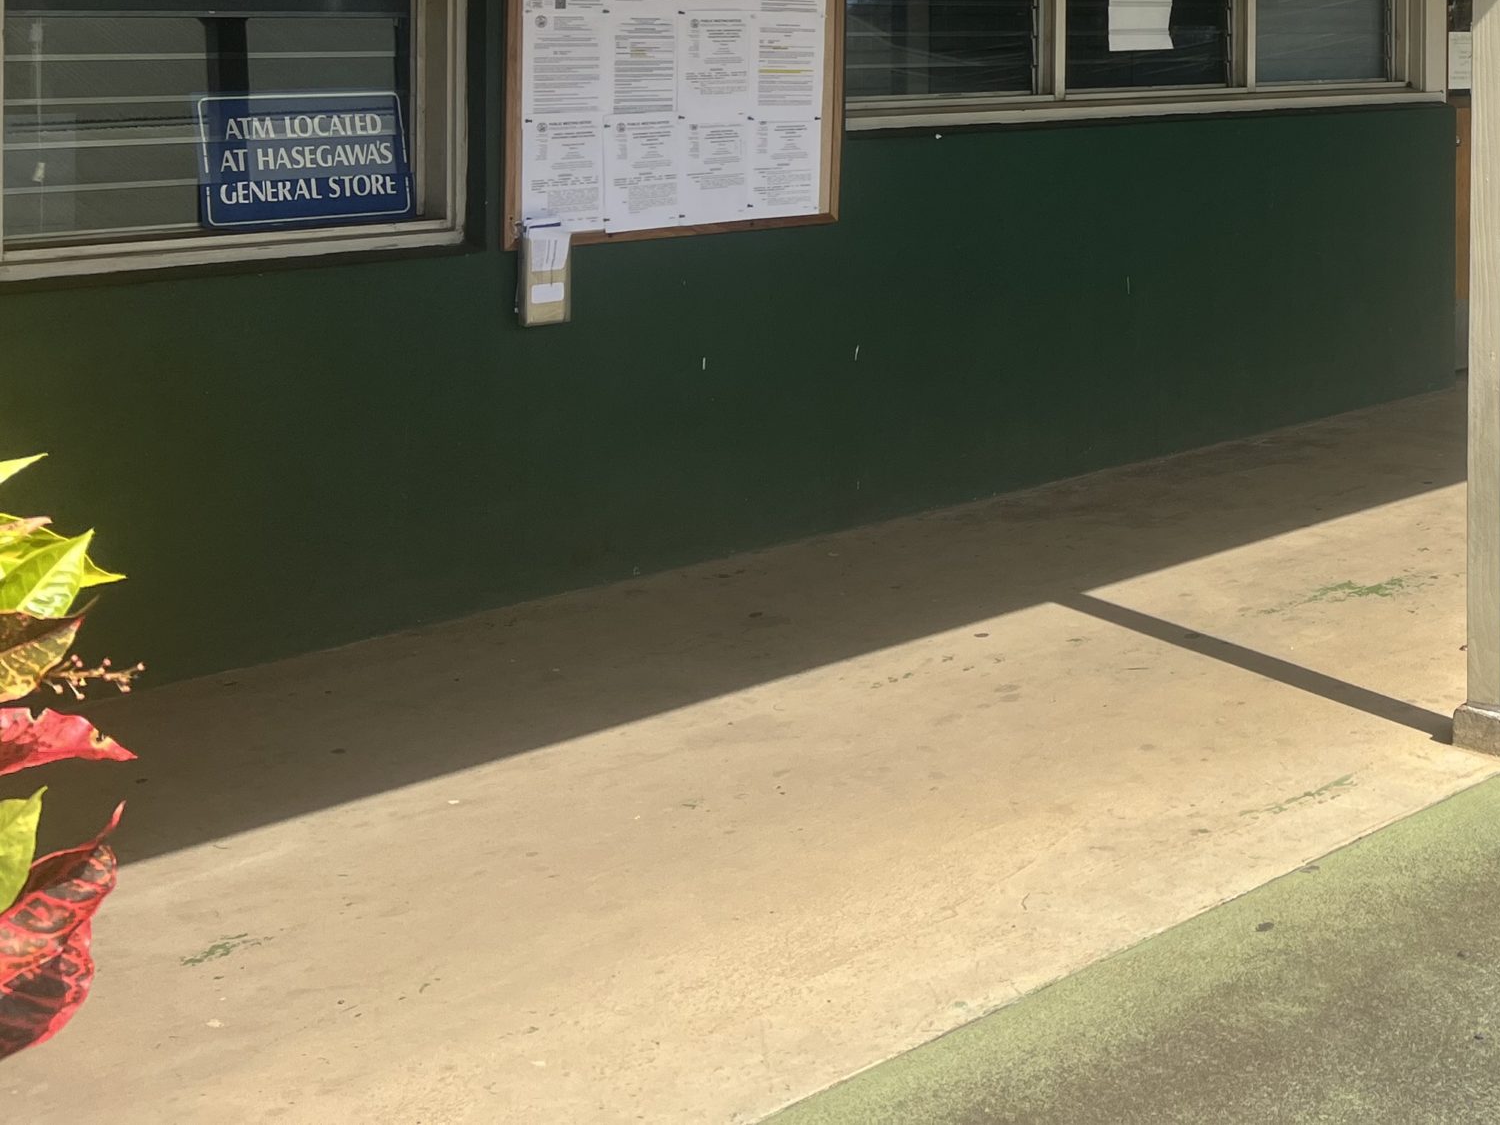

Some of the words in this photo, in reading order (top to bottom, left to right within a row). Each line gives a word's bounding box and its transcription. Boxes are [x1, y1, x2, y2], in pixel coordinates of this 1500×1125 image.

[226, 116, 275, 140] ATM
[284, 113, 382, 138] LOCATED
[221, 148, 248, 172] AT
[257, 141, 393, 171] HASEGAWA'S
[220, 178, 322, 205] GENERAL
[328, 173, 397, 198] STORE
